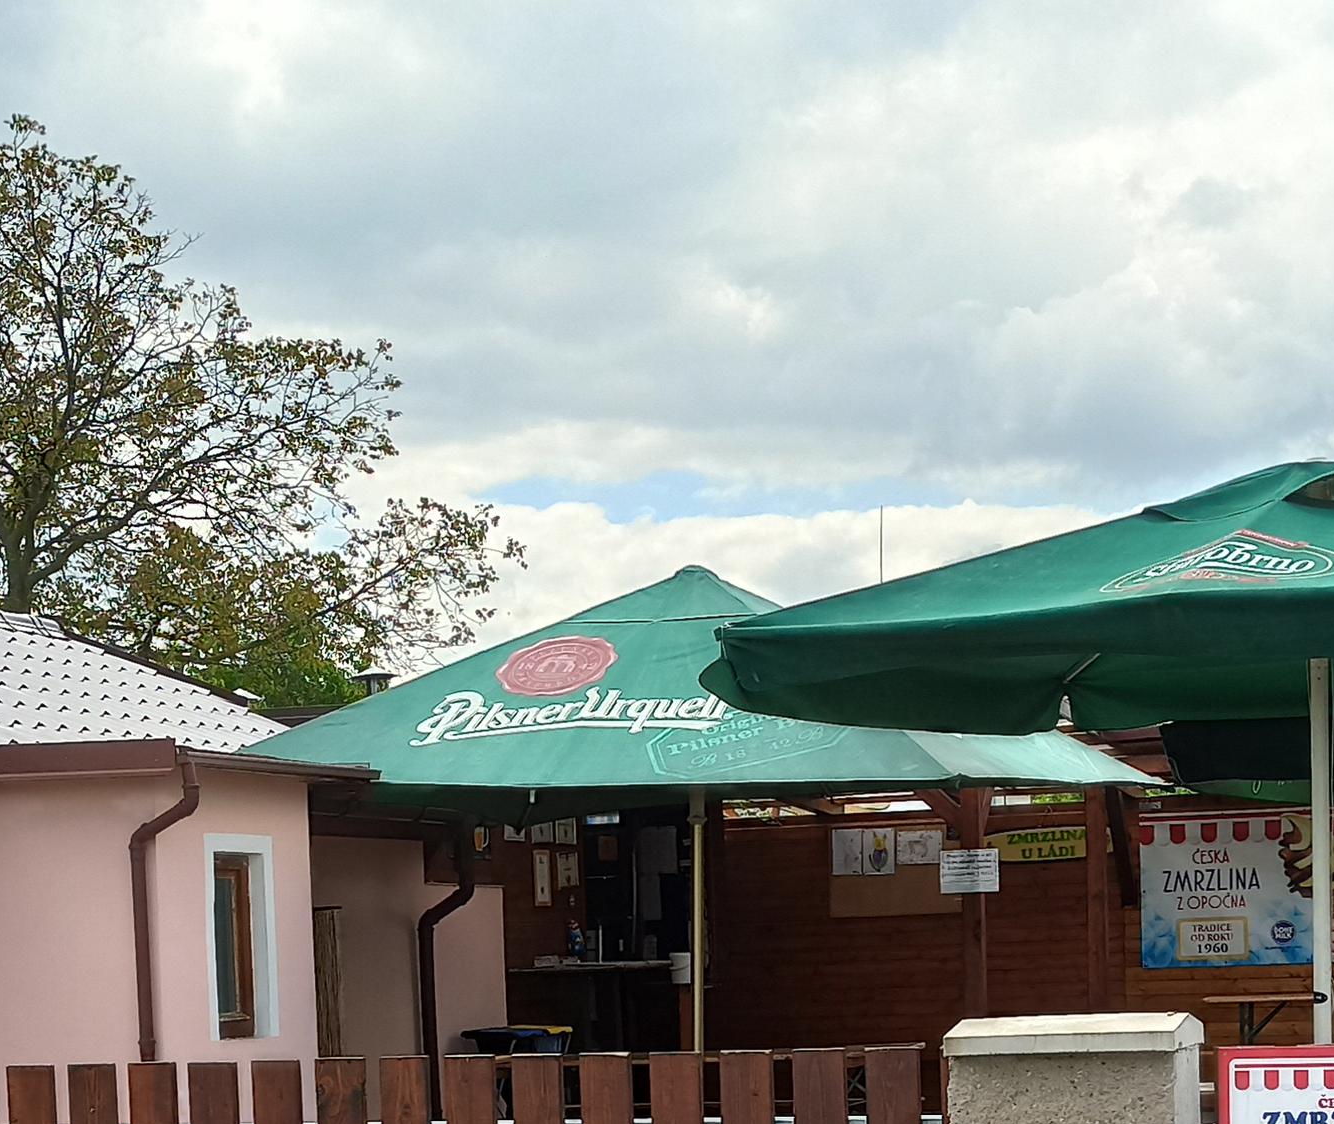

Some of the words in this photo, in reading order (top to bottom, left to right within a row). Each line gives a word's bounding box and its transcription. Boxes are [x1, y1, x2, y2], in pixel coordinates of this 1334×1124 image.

[409, 690, 585, 747] Pilsner
[666, 727, 764, 755] Pilsner
[1021, 848, 1035, 859] U
[1037, 843, 1076, 859] LÁDI
[1192, 847, 1230, 864] ČESKÁ
[1162, 867, 1261, 893] ZMRZLINA
[1177, 897, 1184, 910] Z
[1186, 893, 1246, 910] OPOČNA
[1192, 923, 1232, 933] TRADICE
[1190, 934, 1206, 942] OD
[1207, 933, 1233, 942] ROKU
[1197, 943, 1228, 953] 1960
